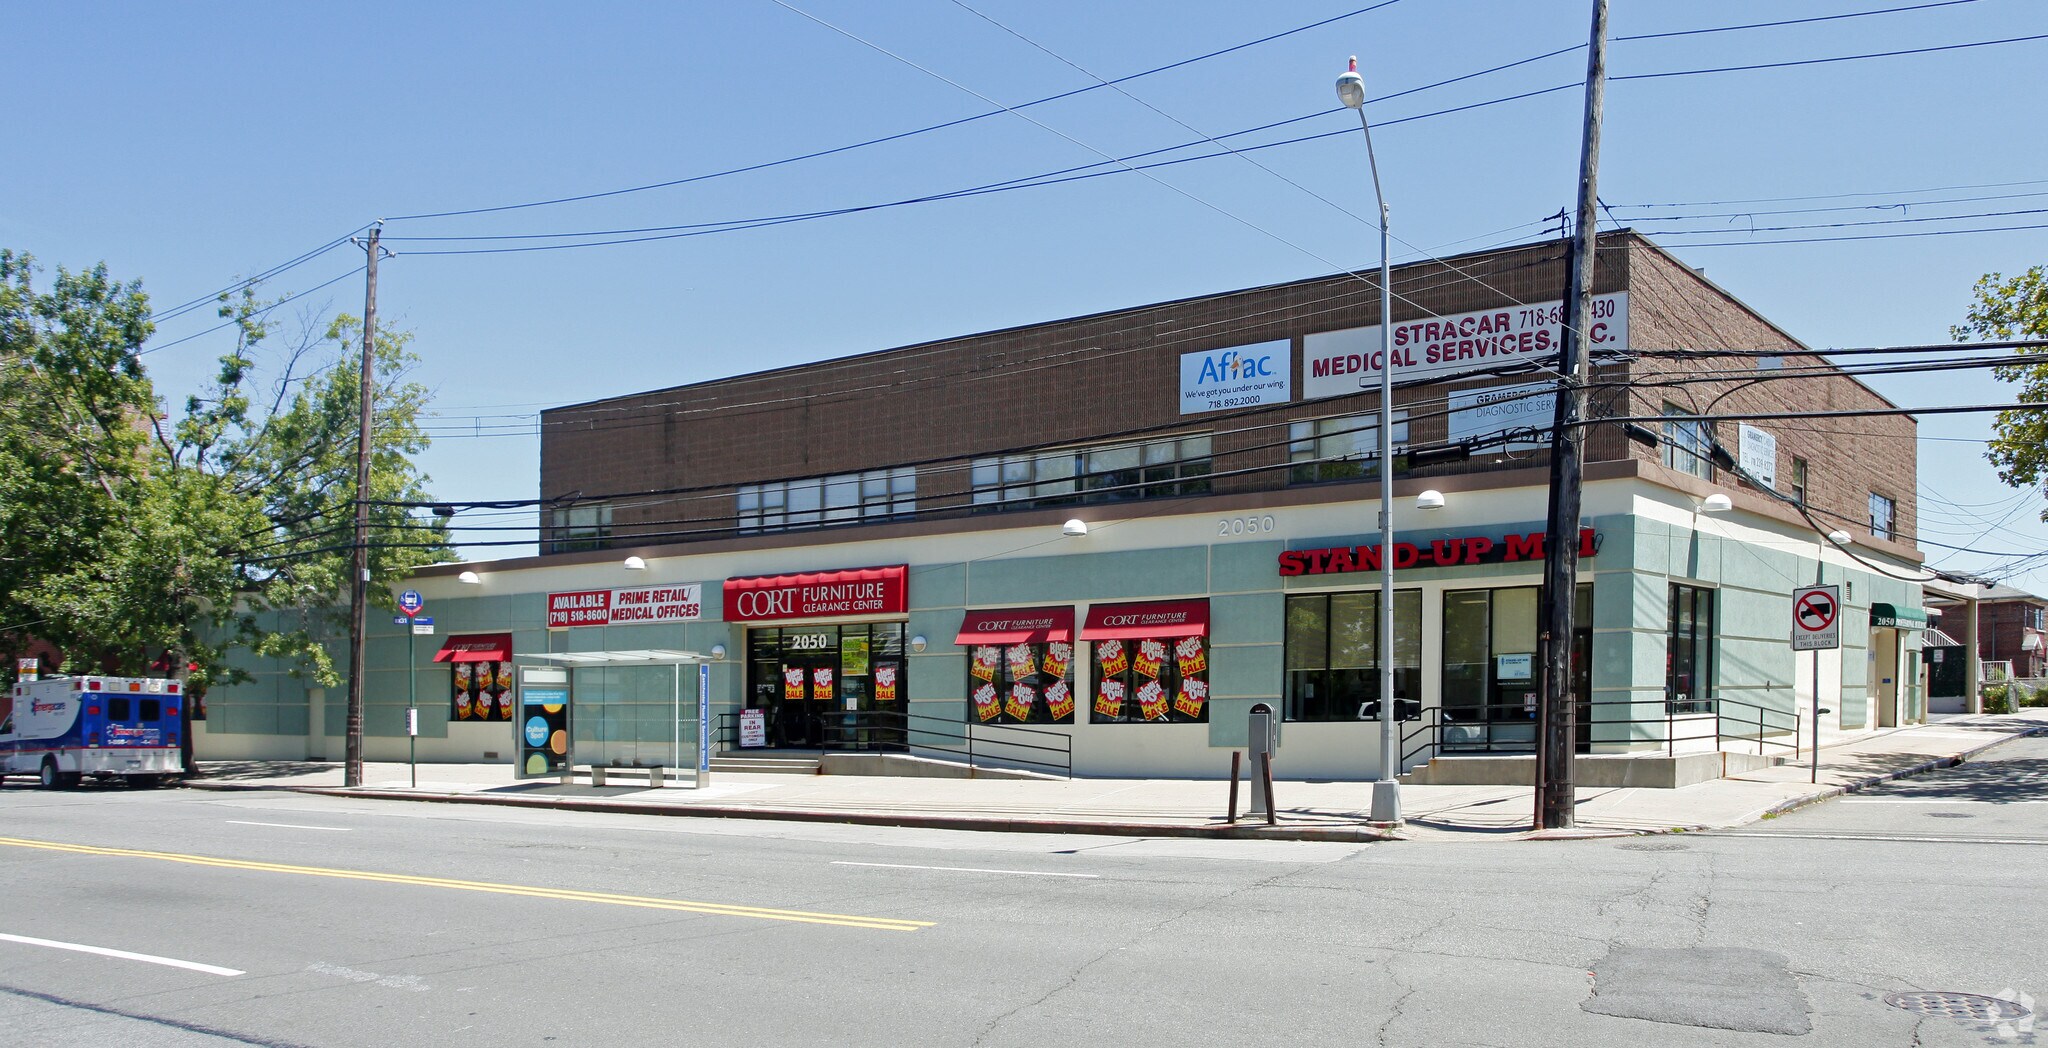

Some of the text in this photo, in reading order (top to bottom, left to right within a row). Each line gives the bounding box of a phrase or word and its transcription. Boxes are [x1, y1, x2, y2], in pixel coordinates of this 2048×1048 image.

[1394, 299, 1615, 346] STRACAR 718-68430
[1313, 322, 1615, 378] MEDICAL SERVICES, C.
[1198, 351, 1271, 384] Aflac
[1185, 390, 1205, 399] We've
[1206, 388, 1218, 398] got
[1218, 387, 1231, 397] you
[1232, 384, 1252, 393] under
[1266, 380, 1285, 389] wing.
[1477, 399, 1556, 418] DIAGNOSTIC SERV
[1218, 515, 1275, 537] 2050
[1278, 528, 1595, 577] STAND-UP MI
[553, 588, 691, 609] AVAILABLE PRIME RETAIL/
[737, 582, 884, 617] CORT FURNITURE
[802, 599, 883, 613] CLEARANCE CENTER
[550, 603, 699, 625] (718) 518-8600 MEDICAL OFFICES
[1104, 612, 1187, 626] CORT FURNITURE
[1877, 617, 1895, 626] 2050
[978, 618, 1054, 631] CORT FURNITURE
[793, 634, 826, 649] 2050
[971, 667, 992, 681] SALE
[1014, 664, 1035, 679] SALE
[1043, 663, 1065, 677] SALE
[1105, 660, 1128, 677] SALE
[1134, 661, 1158, 677] SALE
[1181, 660, 1206, 677] SALE
[786, 690, 803, 698] SALE
[814, 690, 832, 698] SALE
[876, 691, 894, 699] SALE
[980, 705, 1000, 720] SALE
[1006, 704, 1026, 720] SALE
[1052, 702, 1075, 720] SALE
[1096, 702, 1118, 717] SALE
[1175, 700, 1200, 718] SALE
[530, 732, 544, 740] Spot
